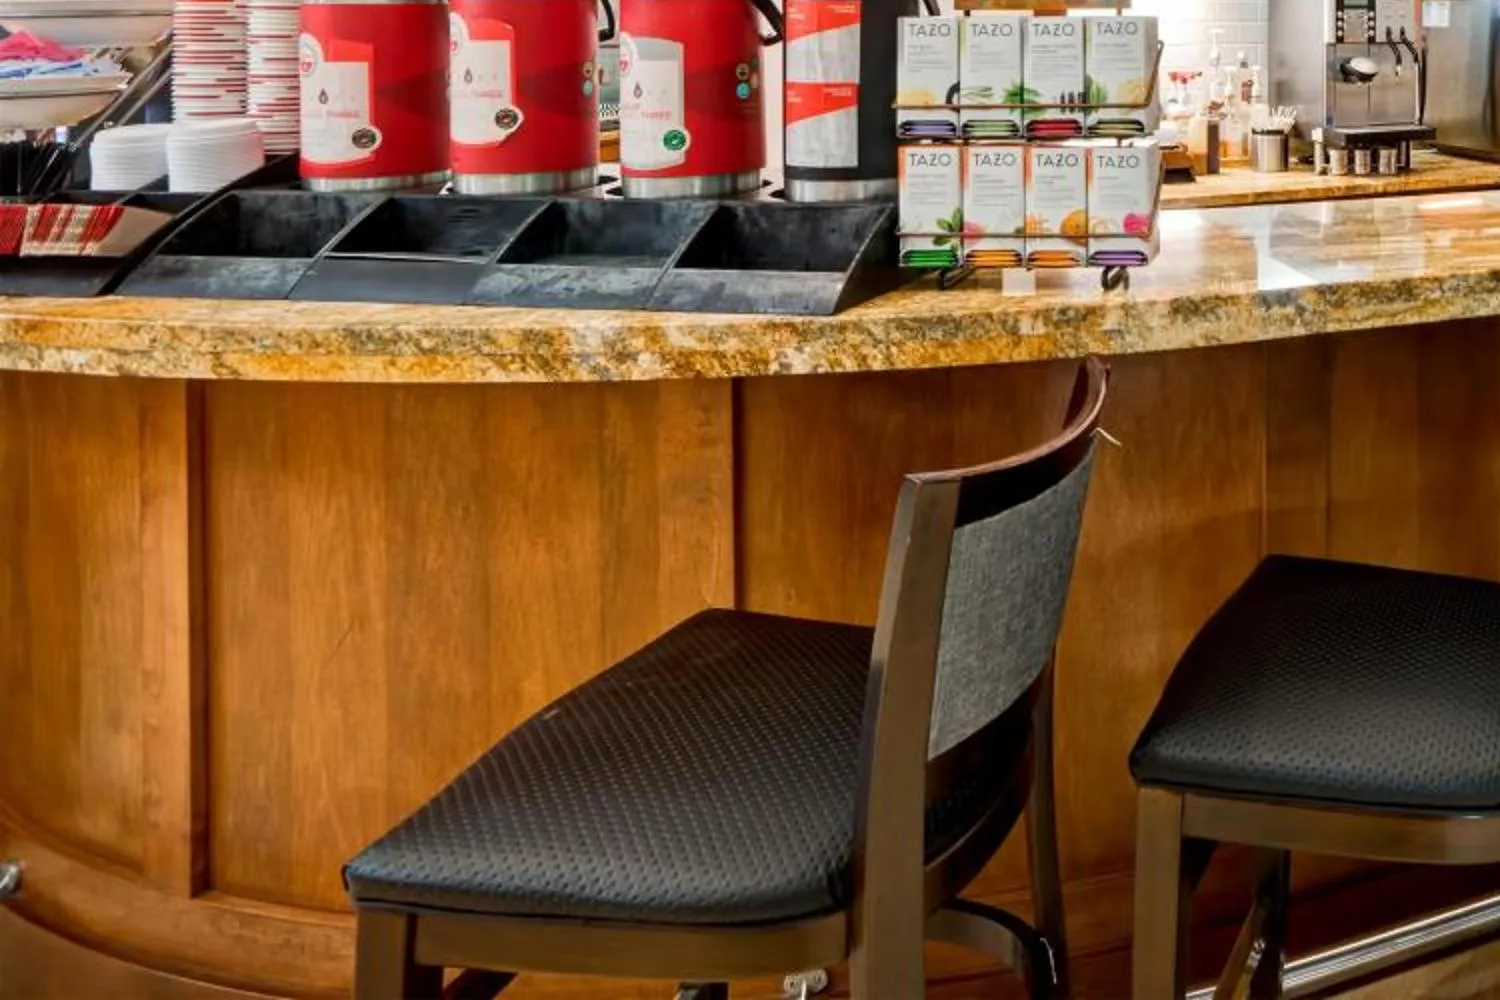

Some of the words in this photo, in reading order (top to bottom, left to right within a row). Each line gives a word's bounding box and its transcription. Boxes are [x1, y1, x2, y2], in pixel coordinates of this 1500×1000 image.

[907, 23, 951, 37] TAZO
[969, 23, 1013, 37] TAZO
[1031, 23, 1075, 37] TAZO
[1096, 21, 1138, 36] TAZO
[909, 152, 952, 167] TAZO
[973, 152, 1017, 167] TAZO
[1036, 153, 1079, 168] TAZO
[1096, 155, 1140, 169] TAZO
